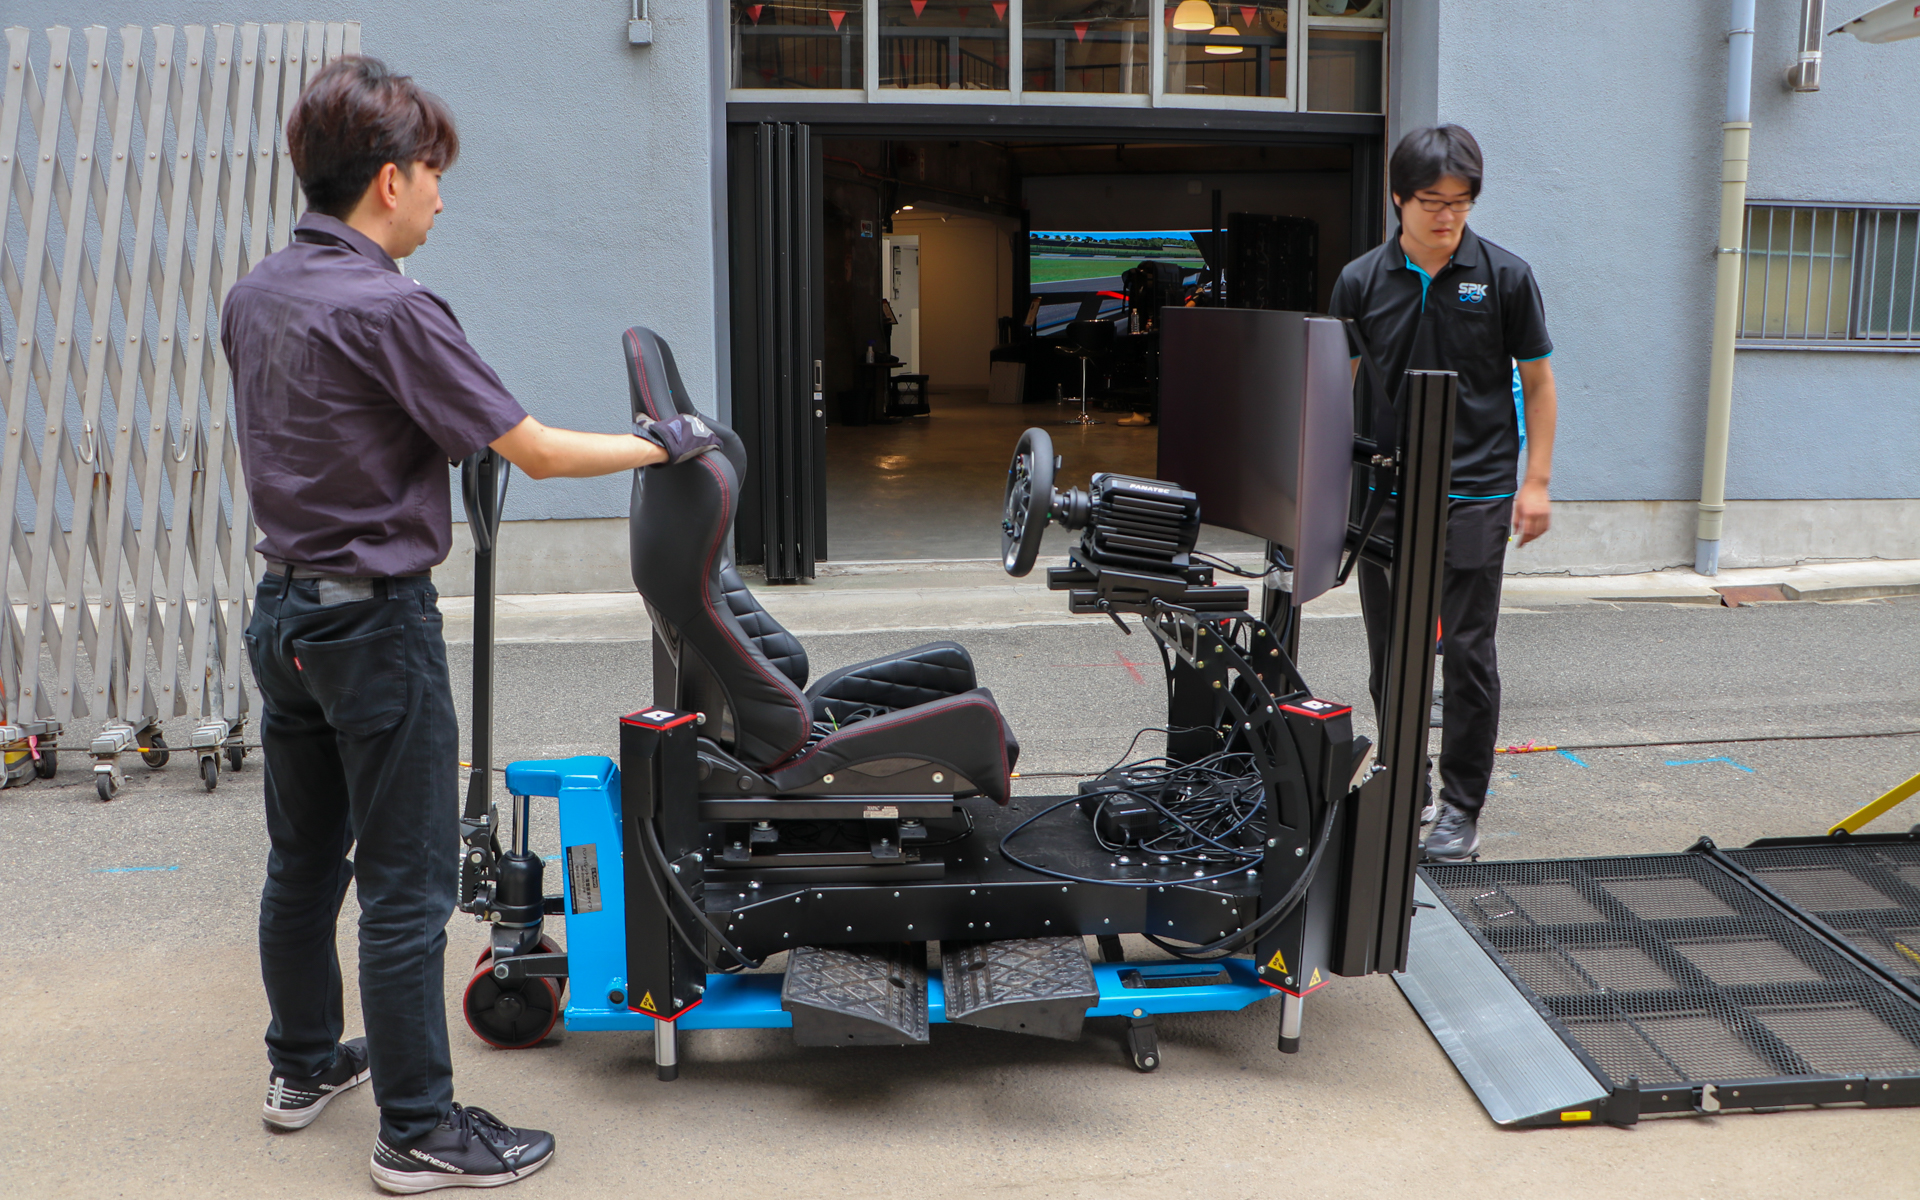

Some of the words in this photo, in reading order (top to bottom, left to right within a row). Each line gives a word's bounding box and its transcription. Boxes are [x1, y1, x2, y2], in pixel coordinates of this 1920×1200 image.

[1458, 282, 1488, 297] SPK
[1128, 483, 1170, 494] FANATEC
[409, 1148, 464, 1174] alpinestars
